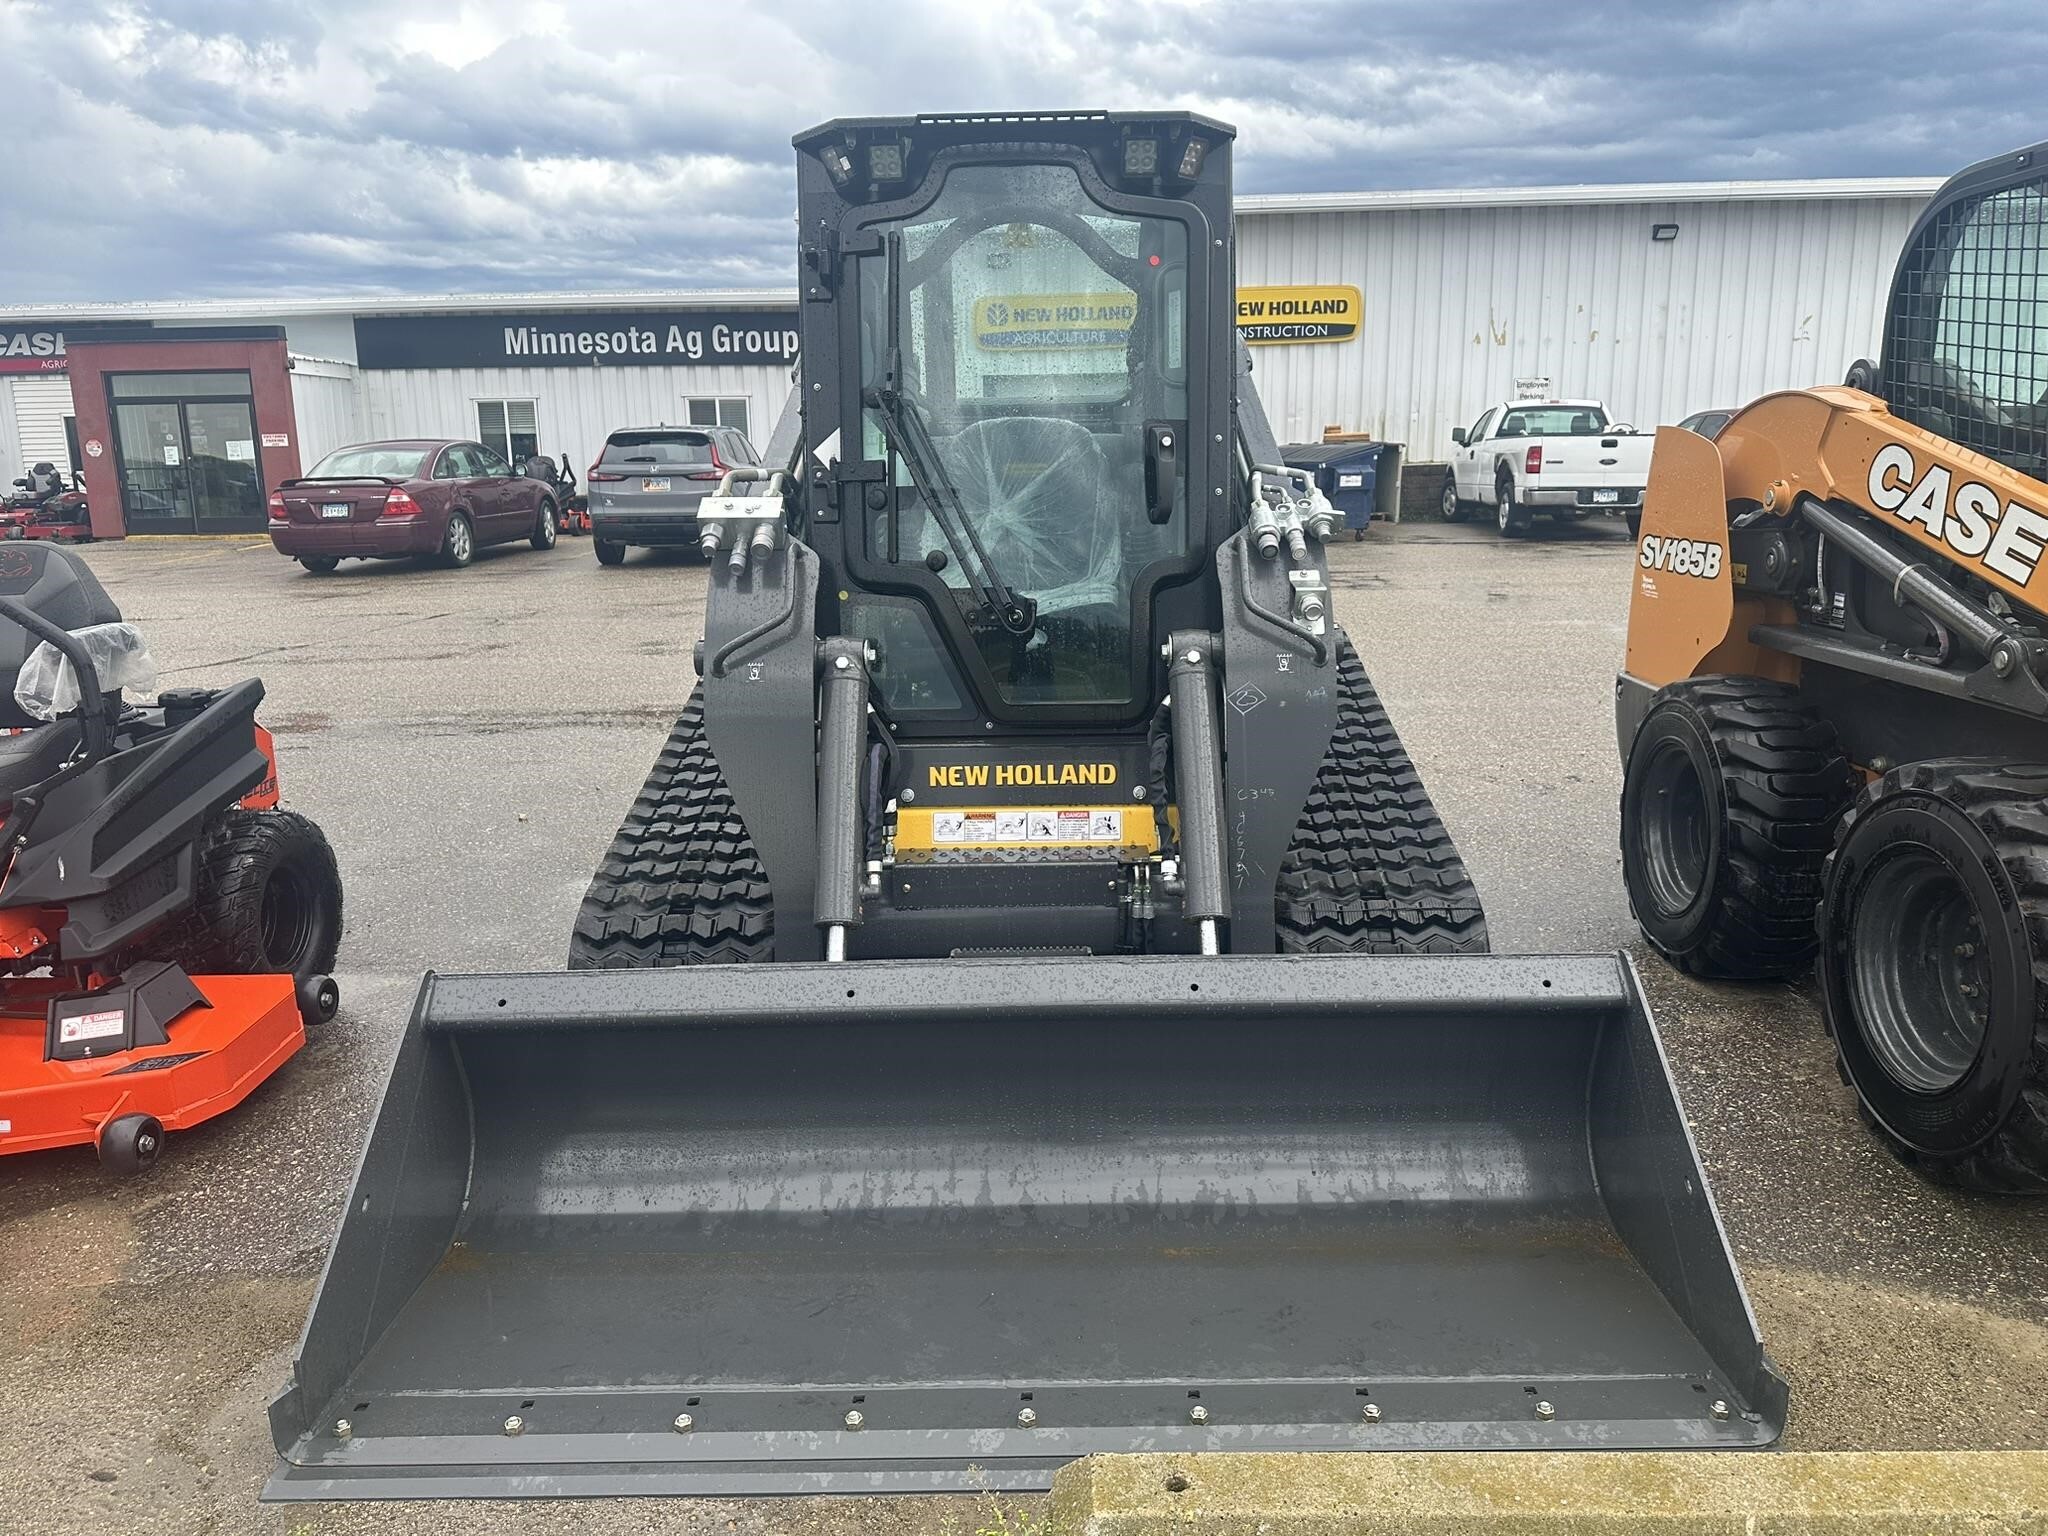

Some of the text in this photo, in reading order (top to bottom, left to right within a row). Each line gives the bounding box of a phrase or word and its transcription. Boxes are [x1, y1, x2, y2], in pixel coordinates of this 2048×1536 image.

[1013, 306, 1133, 323] NEW HOLLAND
[1269, 299, 1349, 316] HOLLAND
[504, 324, 799, 359] Minnesota Ag Group
[1013, 331, 1106, 345] AGRICULTURE
[1516, 381, 1549, 389] Employee
[1867, 443, 2048, 588] CASE
[1639, 533, 1723, 580] SV185B
[928, 763, 1118, 787] NEW HOLLAND
[94, 1011, 123, 1022] DANGER
